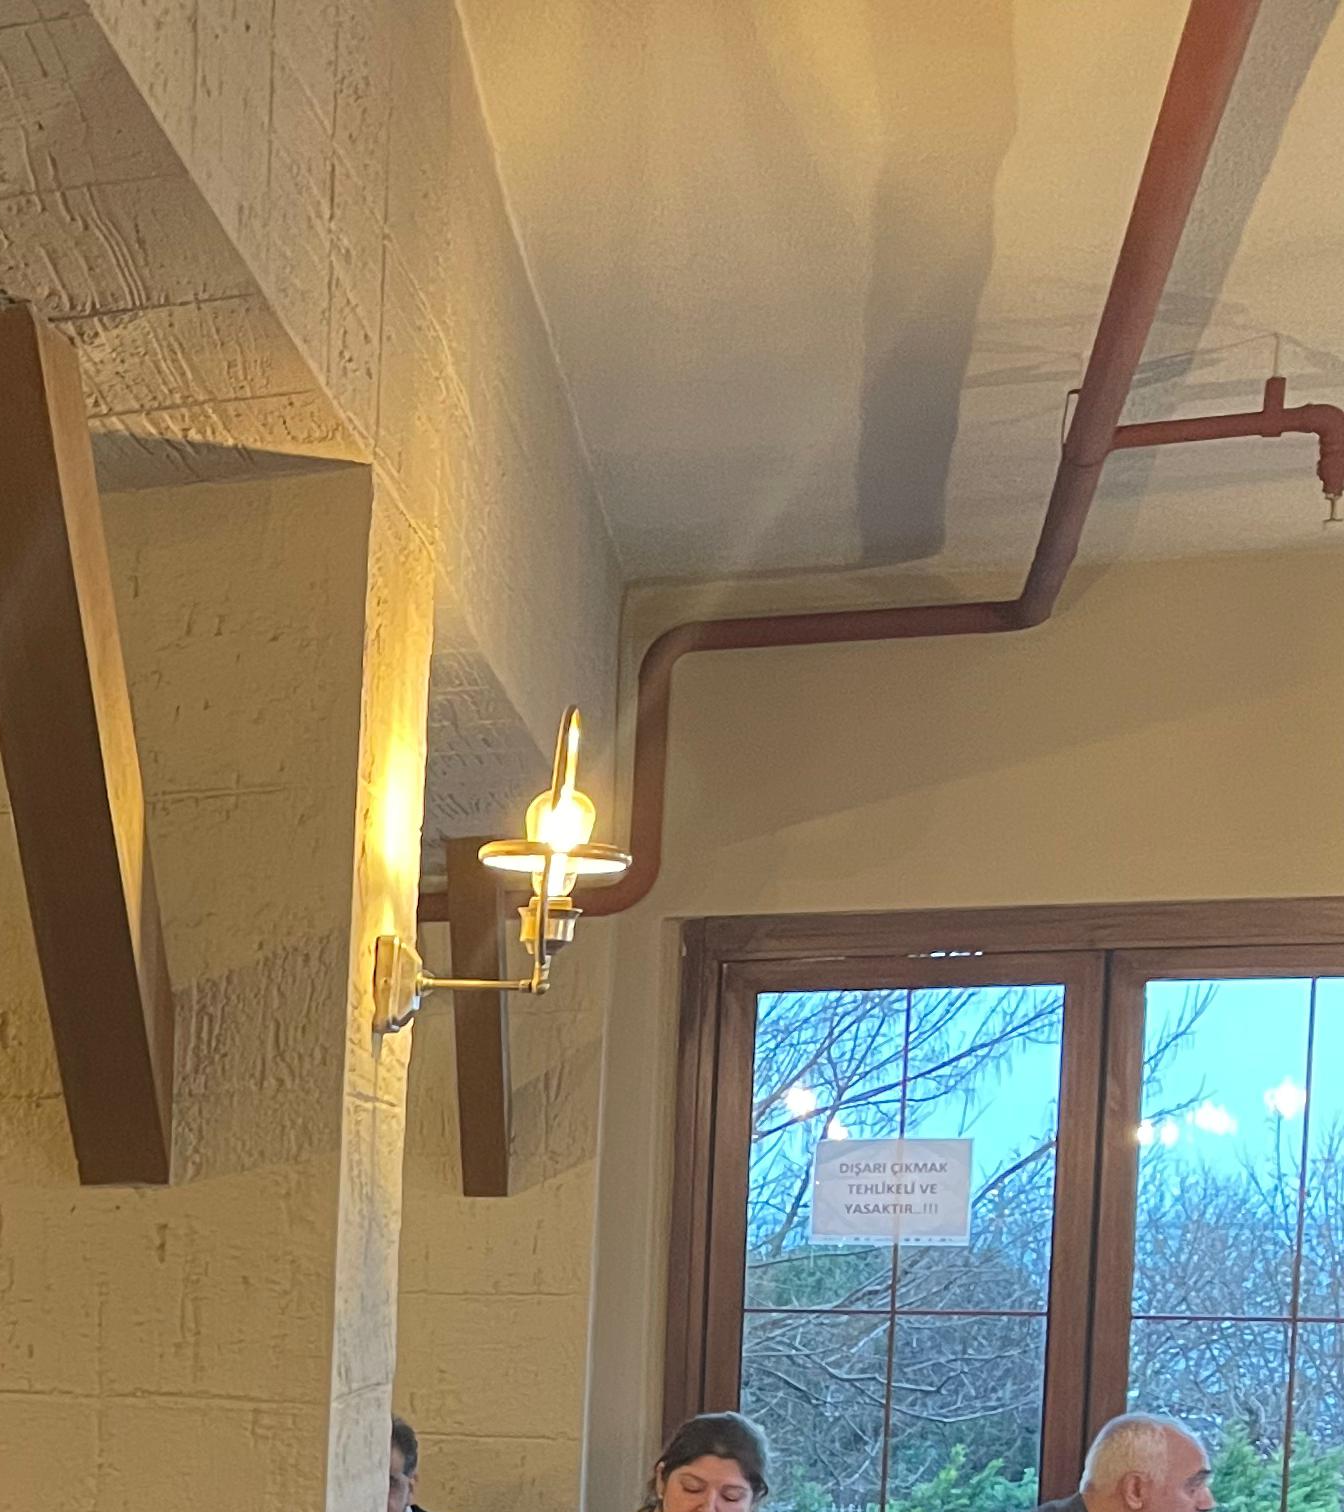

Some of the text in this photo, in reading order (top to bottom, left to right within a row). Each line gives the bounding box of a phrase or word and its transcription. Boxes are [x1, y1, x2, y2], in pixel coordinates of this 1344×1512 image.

[839, 1162, 948, 1176] DIŞARI ÇIKMAK
[848, 1181, 938, 1195] TEHLİKELİ VE
